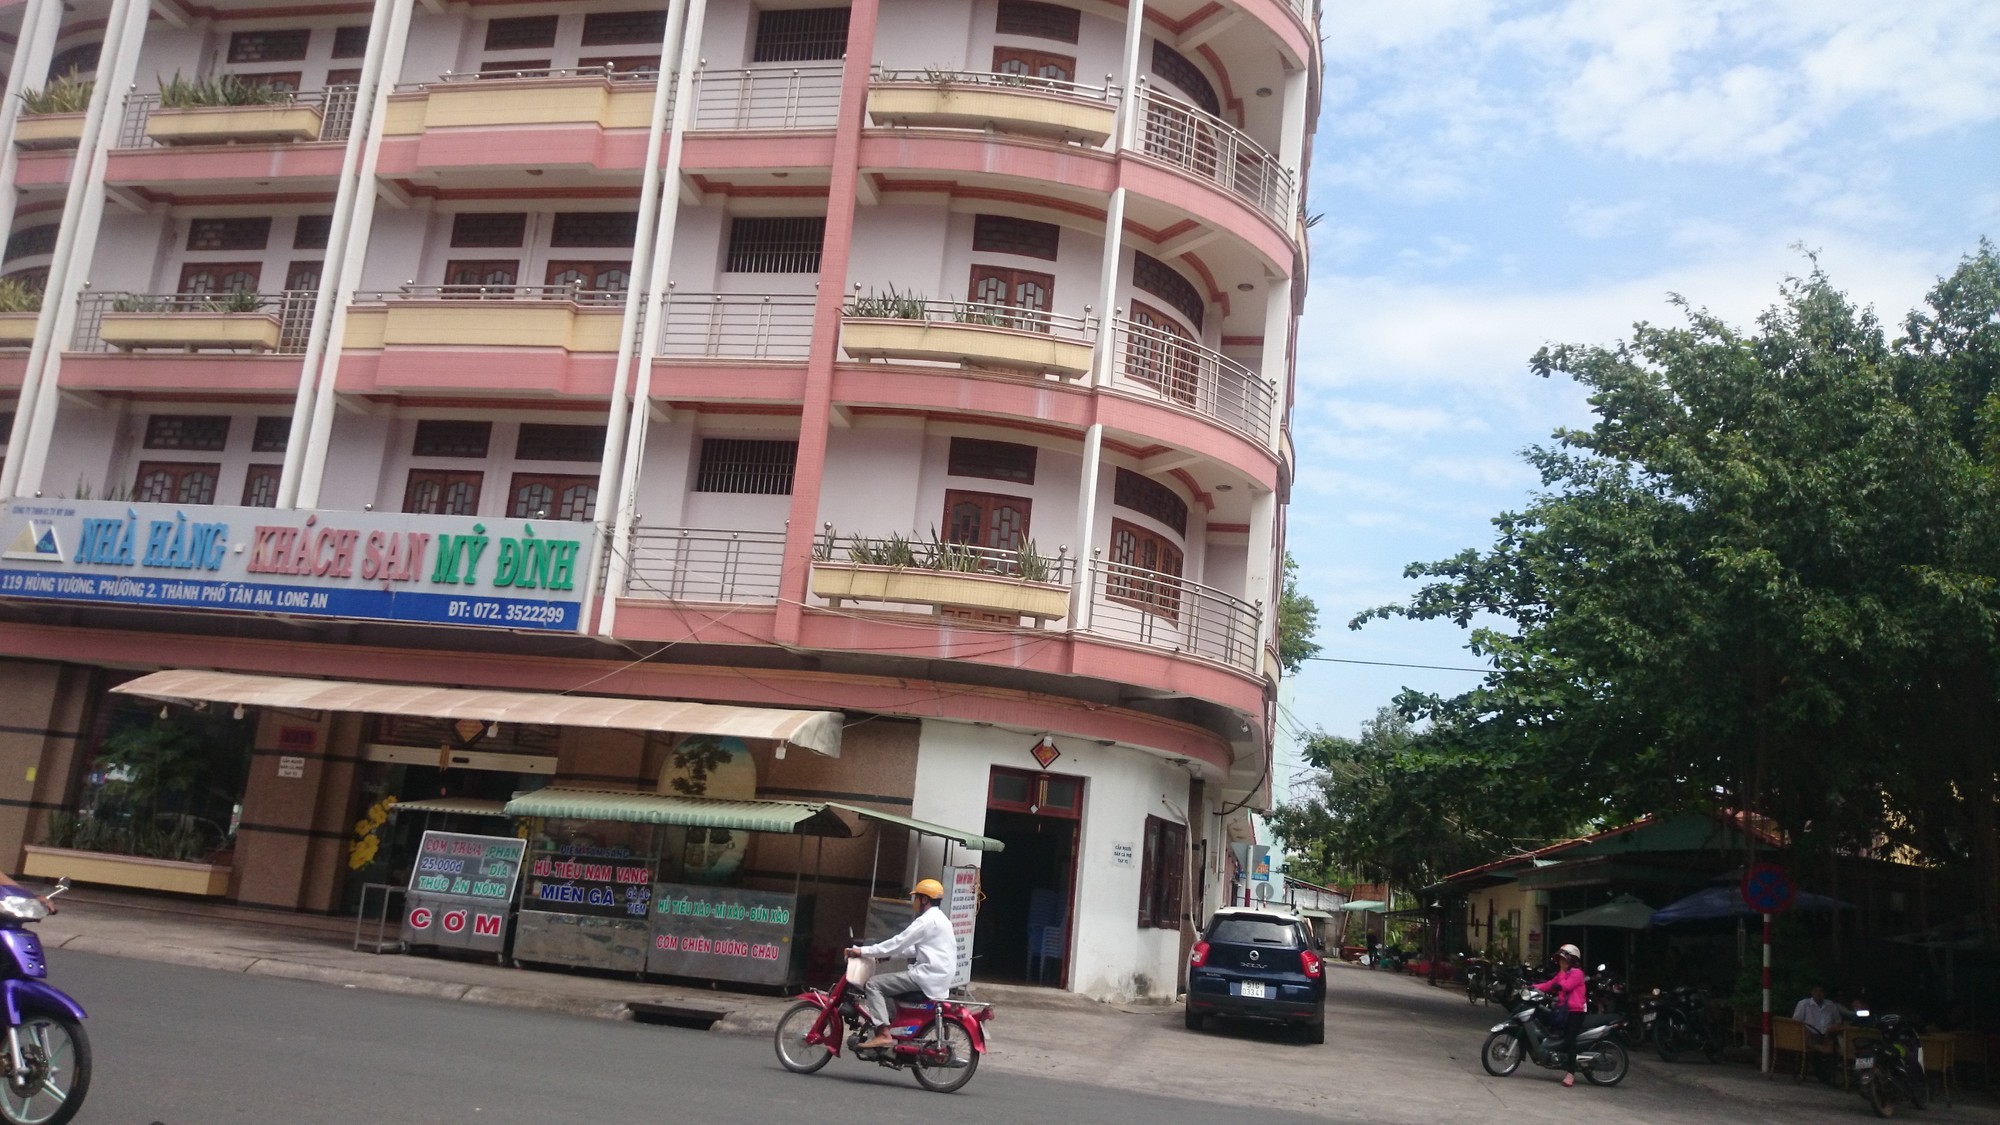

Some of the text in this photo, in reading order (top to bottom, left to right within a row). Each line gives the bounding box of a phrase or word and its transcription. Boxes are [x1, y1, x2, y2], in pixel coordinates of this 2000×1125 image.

[74, 507, 137, 566] NHÀ
[142, 510, 229, 571] HÀNG
[247, 514, 360, 578] KHÁCH
[361, 529, 431, 591] SẠN
[493, 523, 580, 590] ĐÌNH
[2, 575, 23, 589] 119
[161, 581, 199, 601] THÀNH
[201, 582, 229, 602] PHỐ
[229, 585, 253, 605] TÂN
[277, 591, 308, 608] LONG
[309, 593, 328, 609] AN
[448, 601, 471, 618] ĐT:
[505, 604, 565, 623] 3522299
[554, 857, 583, 880] TIẾU
[584, 863, 613, 882] NAM
[616, 866, 649, 885] VANG
[472, 879, 507, 898] NÓNG
[540, 881, 615, 906] MIẾN GÀ
[750, 904, 769, 922] BÚN
[769, 906, 789, 925] XÀO
[751, 942, 779, 960] CHÂU
